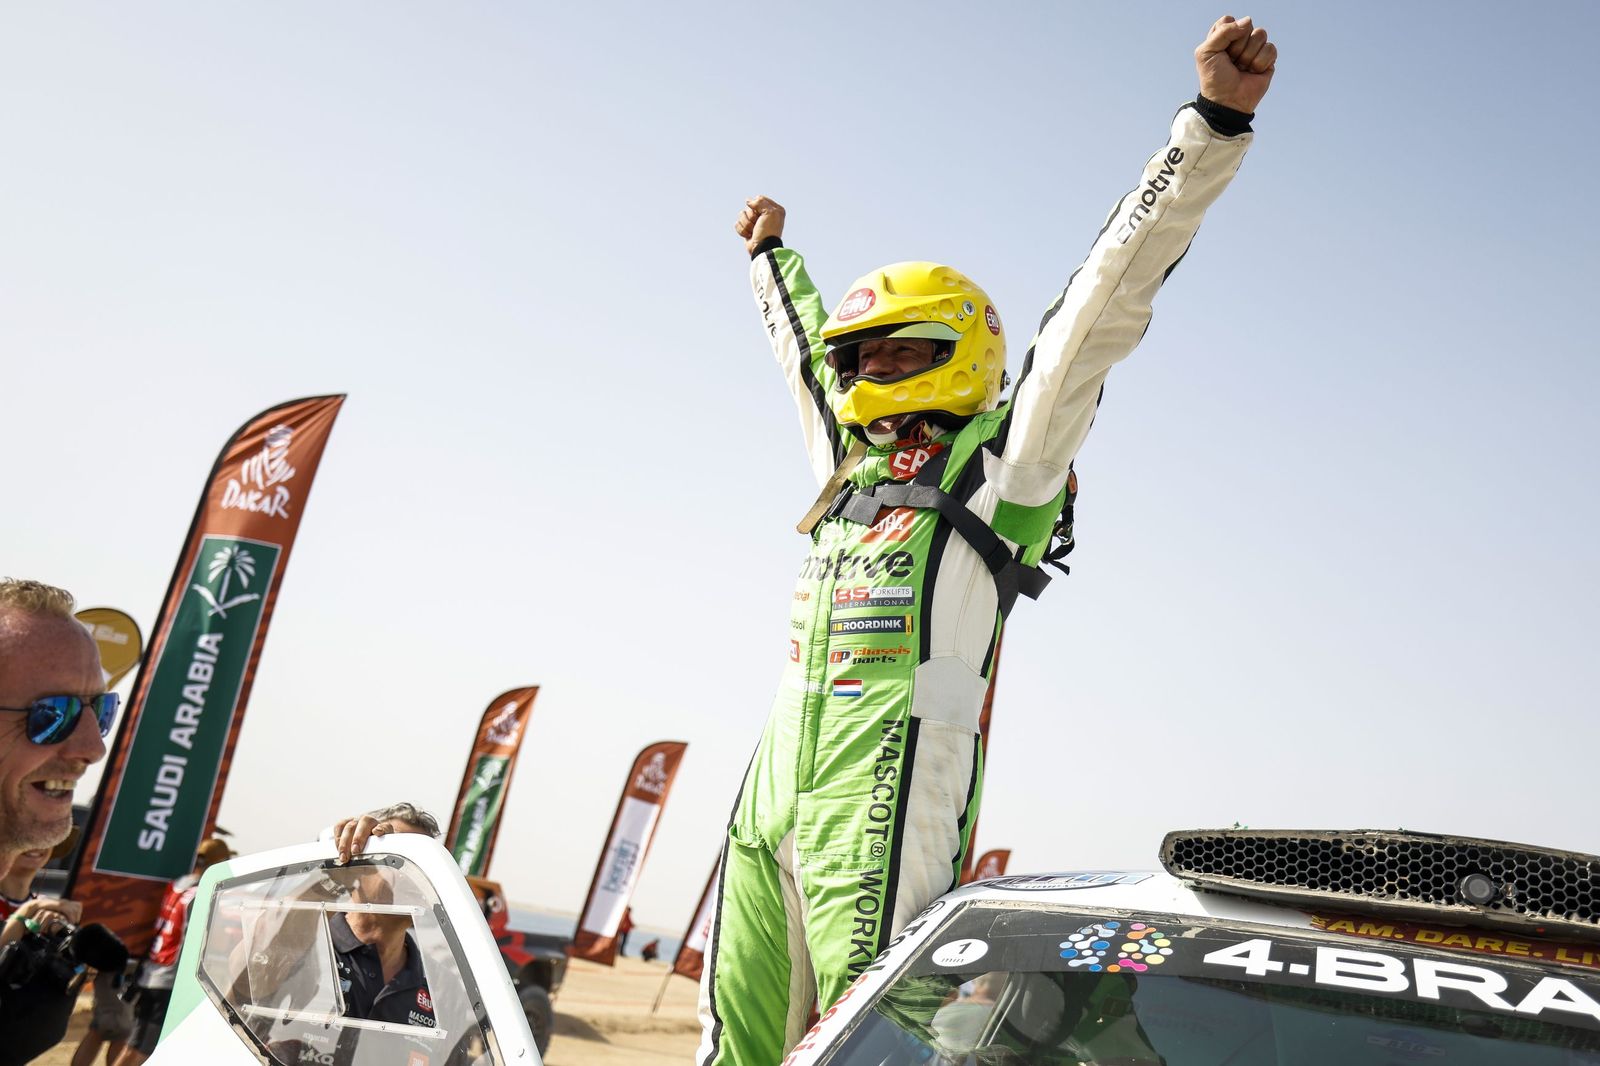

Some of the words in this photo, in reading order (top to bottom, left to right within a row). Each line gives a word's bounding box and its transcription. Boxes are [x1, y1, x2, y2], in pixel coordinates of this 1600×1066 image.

[221, 479, 290, 519] DAKAR
[834, 586, 870, 603] BS
[870, 587, 911, 596] FORKLIFTS
[834, 599, 910, 609] INTERNATIONAL
[843, 619, 902, 630] ROORDINK
[852, 655, 897, 665] parts
[138, 756, 189, 852] SAUDI
[173, 632, 224, 750] ARABIA
[958, 942, 972, 955] 1
[1414, 929, 1544, 957] DARE.
[1555, 947, 1600, 967] LI
